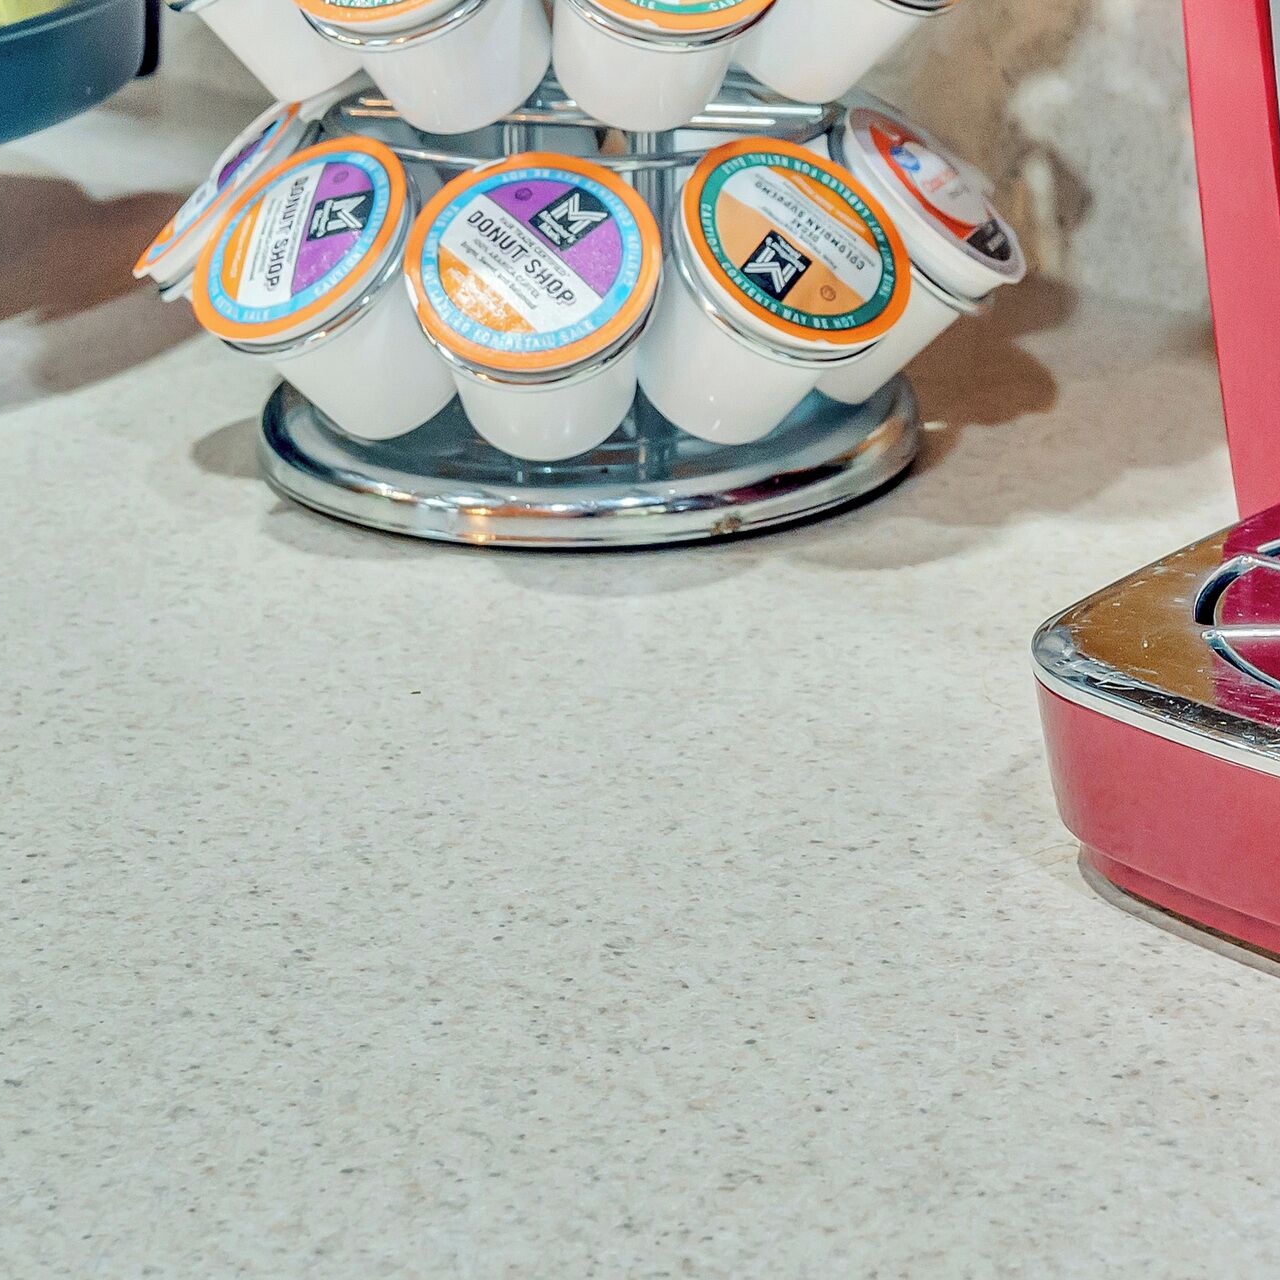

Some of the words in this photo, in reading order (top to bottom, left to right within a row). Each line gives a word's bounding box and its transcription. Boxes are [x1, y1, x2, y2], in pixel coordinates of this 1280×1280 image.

[262, 237, 289, 289] SHOP
[466, 209, 529, 262] DONUT
[521, 257, 577, 306] SHOP
[800, 214, 866, 271] COLOMBIAN
[719, 260, 777, 313] CONTENTS
